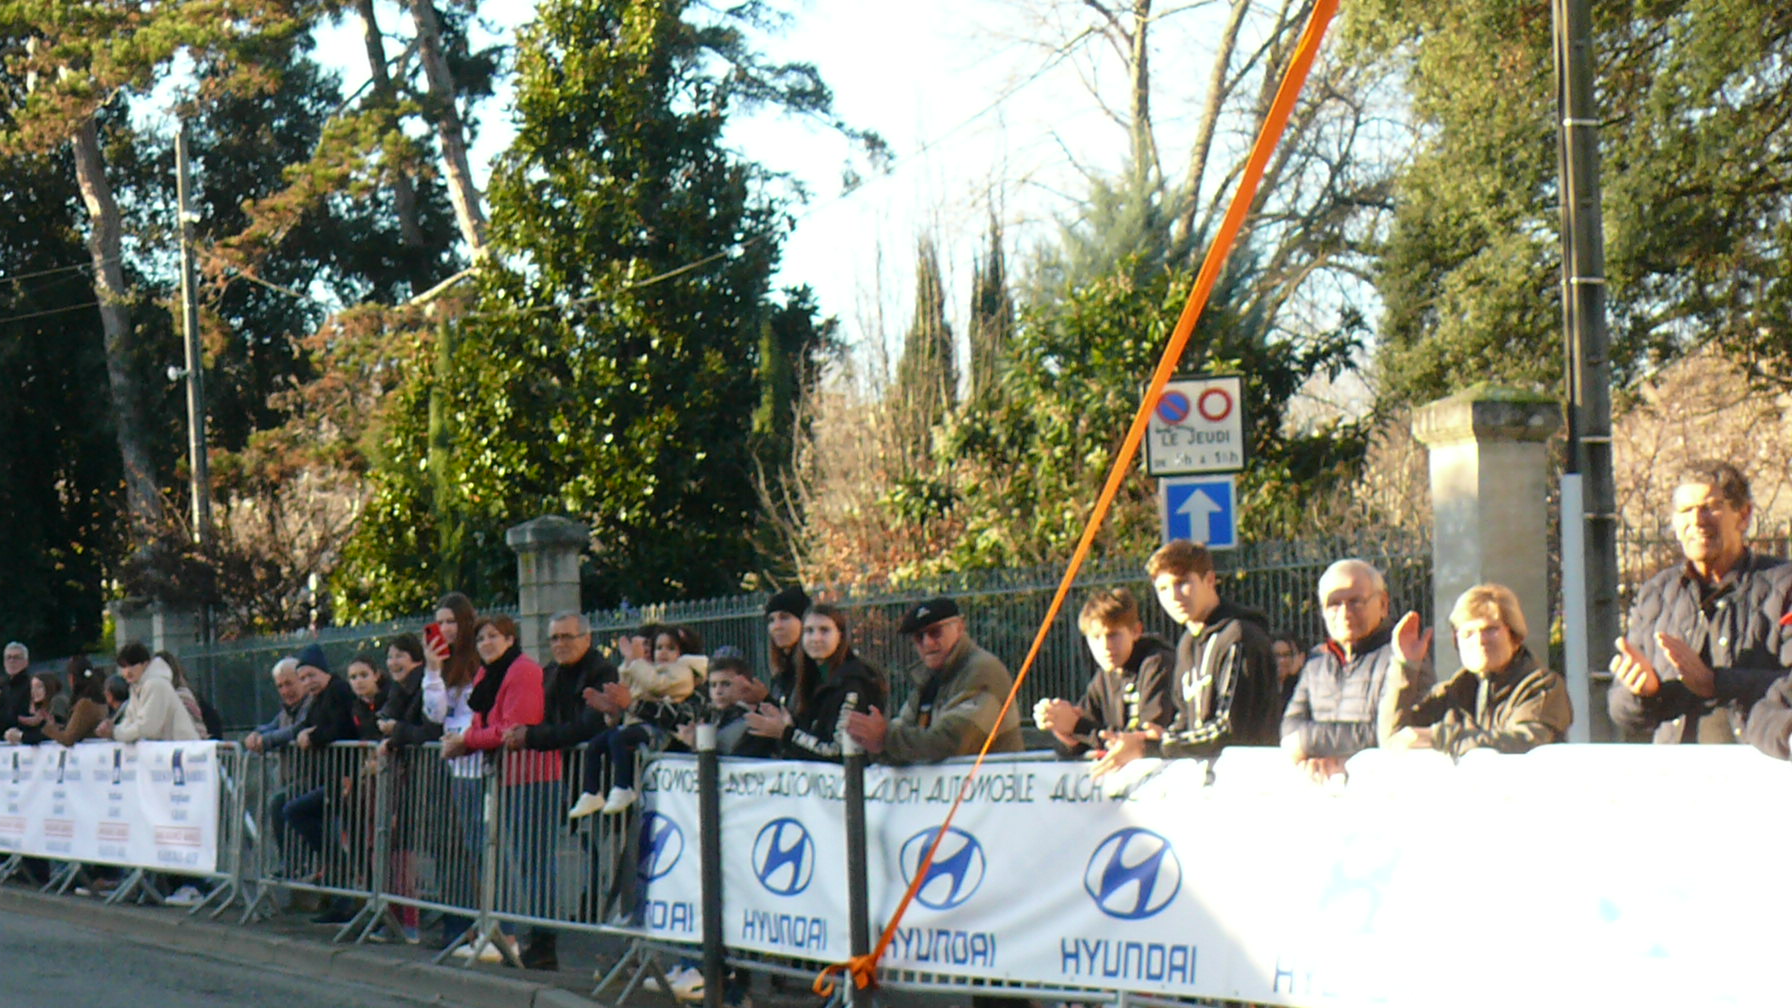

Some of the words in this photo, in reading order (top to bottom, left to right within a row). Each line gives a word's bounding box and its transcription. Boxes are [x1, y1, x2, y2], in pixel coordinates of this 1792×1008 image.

[1161, 432, 1178, 447] LE
[1187, 429, 1230, 446] JEUDI
[742, 908, 828, 951] HYUNDAI
[1061, 936, 1197, 985] HYUNDAI
